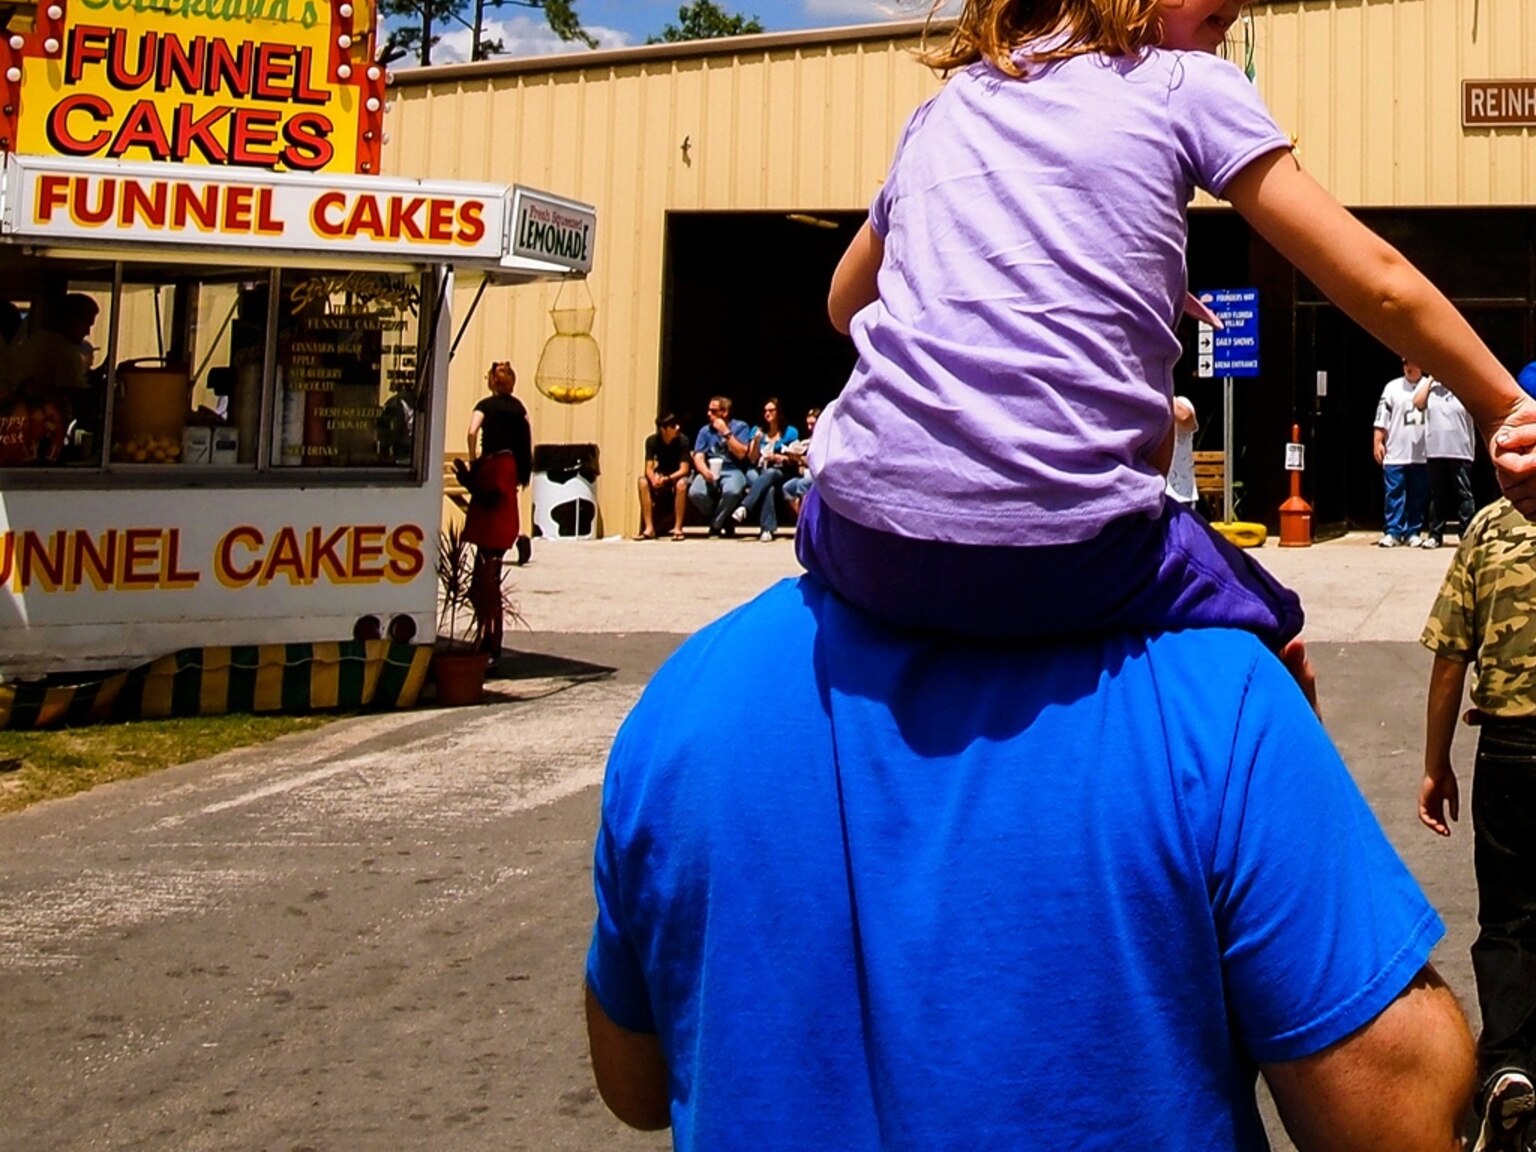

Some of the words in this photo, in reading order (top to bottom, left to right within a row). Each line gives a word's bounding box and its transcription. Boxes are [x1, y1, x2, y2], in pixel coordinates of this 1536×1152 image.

[64, 23, 332, 105] FUNNEL
[47, 93, 335, 172] CAKES
[35, 175, 284, 235] FUNNEL
[310, 192, 485, 244] CAKES
[519, 209, 588, 261] LEMONADE
[214, 524, 425, 587] CAKES
